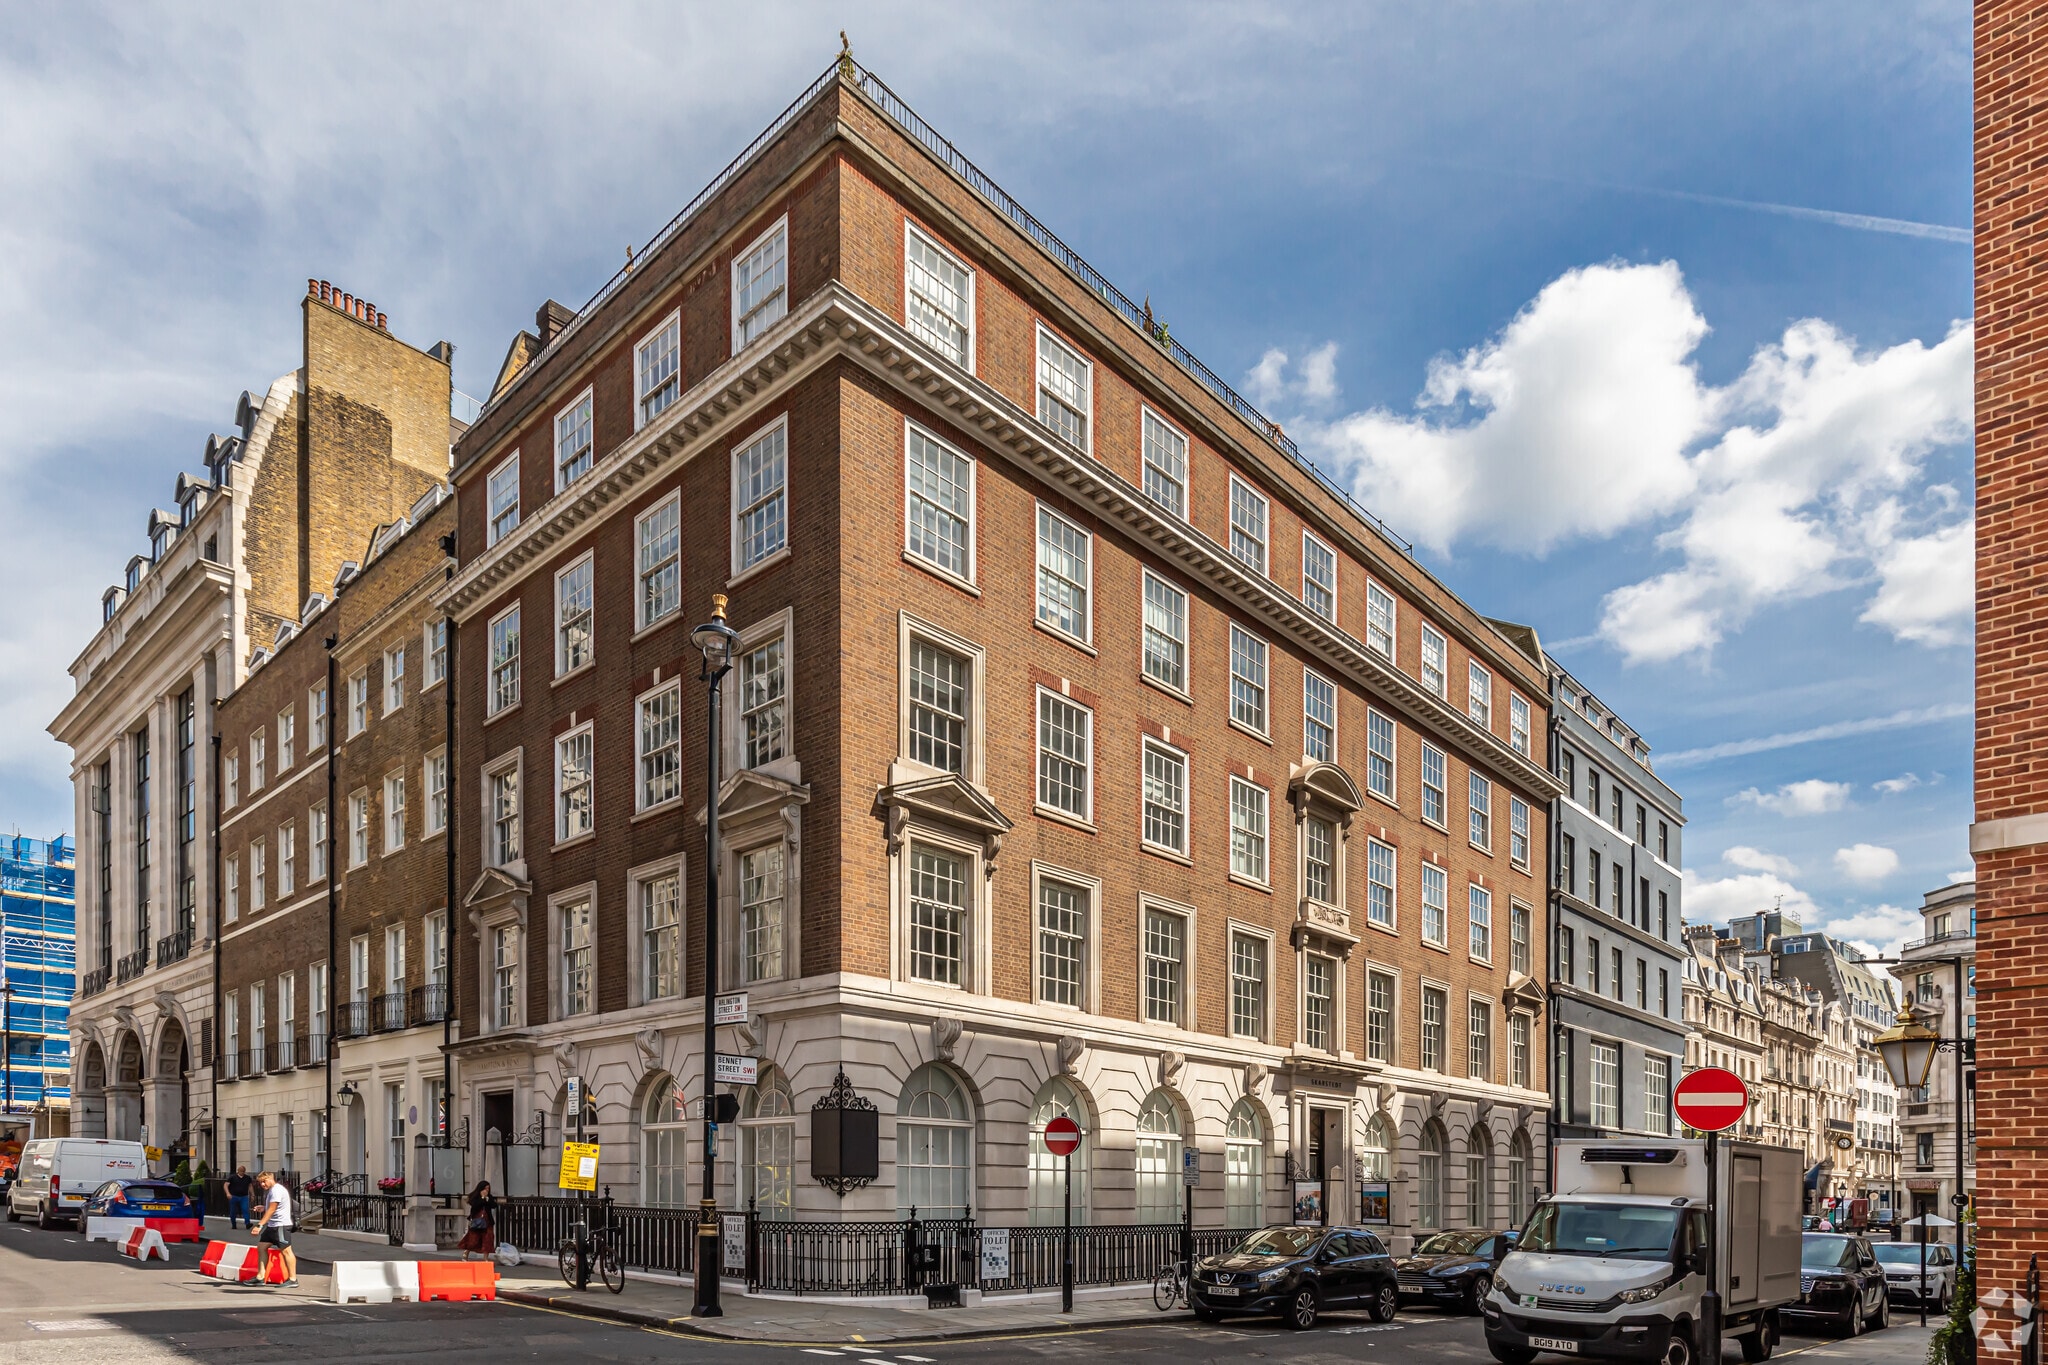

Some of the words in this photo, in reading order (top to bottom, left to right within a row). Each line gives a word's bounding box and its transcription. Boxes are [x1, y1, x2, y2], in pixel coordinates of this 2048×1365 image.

[718, 996, 741, 1006] ARLINGTON
[718, 1005, 733, 1014] STREET
[734, 1004, 743, 1012] SW1
[717, 1056, 742, 1065] BENNET
[717, 1064, 740, 1073] STREET
[742, 1066, 755, 1074] SW1
[1311, 1079, 1342, 1088] SKARSTEDT
[725, 1223, 733, 1231] TO
[733, 1224, 744, 1232] LET
[984, 1236, 994, 1245] TO
[994, 1236, 1008, 1245] LET
[1538, 1281, 1586, 1295] IVECO
[1534, 1337, 1553, 1348] BG19
[1555, 1341, 1573, 1350] ATO
